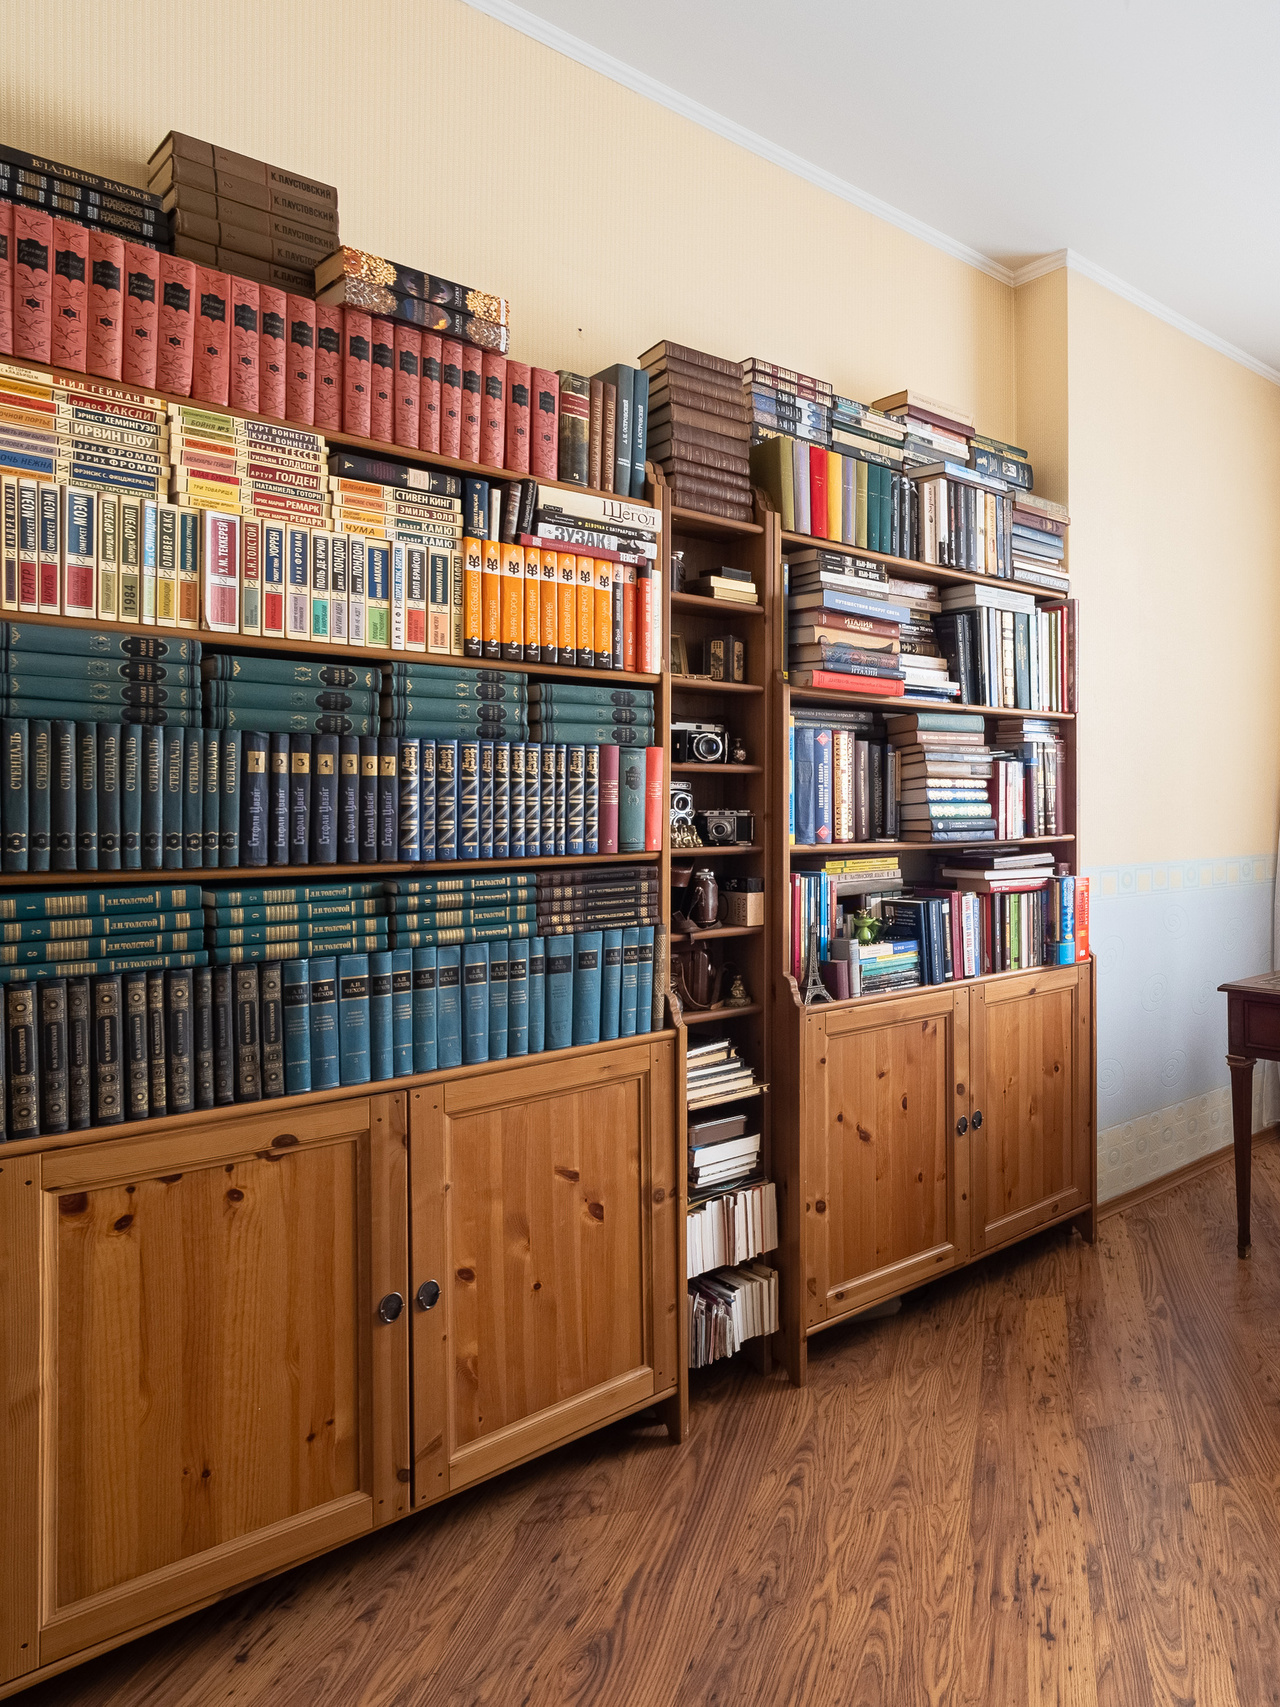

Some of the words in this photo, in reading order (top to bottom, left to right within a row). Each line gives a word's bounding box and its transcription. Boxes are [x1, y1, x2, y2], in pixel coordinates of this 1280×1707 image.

[32, 159, 99, 185] ВЛАДИМИР
[59, 379, 85, 391] НИЛ
[91, 385, 141, 403] ГЕЙМАН
[0, 411, 23, 421] ОЧНОЙ
[77, 411, 103, 423] ЭРНЕСТ
[104, 416, 157, 434] ХЕМИНГУЭЙ
[105, 404, 152, 422] ХАКСЛИ
[190, 419, 216, 430] БОЙНЯ
[248, 421, 270, 433] КУРТ
[272, 427, 315, 443] ВОННЕГУТ
[74, 424, 122, 442] ИРВИН
[123, 432, 154, 448] ШОУ
[251, 432, 272, 443] КУРТ
[275, 437, 317, 451] ВОННЕГУТ
[0, 454, 19, 463] ОЧЬ
[21, 457, 53, 470] НЕЖНА
[77, 442, 104, 454] ЭРИХ
[106, 446, 156, 463] ФРОММ
[79, 453, 106, 465] ЭРИХ
[109, 458, 158, 474] ФРОММ
[278, 457, 318, 472] ГОЛДИНГ
[72, 480, 104, 491] ГАБРИЭЛЬ
[73, 467, 102, 478] ФРЭНСИС
[108, 474, 155, 489] ФИЦДЖЕРАЛЬД
[250, 470, 273, 479] АРТУР
[275, 471, 318, 489] ГОЛДЕН
[5, 486, 15, 517] МОРУА
[255, 483, 296, 495] НАТАНИЕЛЬ
[296, 489, 322, 500] ГОТОРН
[395, 490, 429, 504] СТИВЕН
[430, 495, 452, 508] КИНГ
[21, 490, 35, 519] МОЭМ
[43, 493, 56, 520] МОЭМ
[73, 496, 88, 526] МОЭМ
[286, 500, 320, 514] РЕМАРК
[399, 506, 430, 517] ЭМИЛЬ
[432, 511, 454, 522] ЗОЛЯ
[602, 500, 656, 526] Щегол
[104, 503, 115, 534] ОРУЭЛЛ
[124, 508, 136, 540] ОРУЭЛЛ
[163, 512, 173, 533] САКС
[290, 515, 323, 527] РЕМАРК
[421, 521, 454, 535] КАМЮ
[6, 518, 16, 546] АНДРЕ
[27, 518, 35, 550] СОМЕРСЕТ
[47, 521, 56, 551] СОМЕРСЕТ
[217, 521, 229, 557] ТЕККЕРЕЙ
[345, 524, 376, 536] ЧУМА
[554, 526, 606, 549] ЗУЗАК
[162, 535, 173, 567] ОЛИВЕР
[269, 531, 280, 557] УОРРЕН
[294, 534, 303, 565] ФРОММ
[316, 539, 326, 560] КРЮИ
[422, 536, 454, 549] КАМЮ
[316, 559, 327, 570] ДЕ
[334, 540, 346, 575] ЛОНДОН
[353, 544, 364, 578] ЛОНДОН
[374, 550, 382, 583] МАККАЛОУ
[412, 551, 421, 579] БРАЙСОН
[22, 568, 35, 602] ТЕАТР
[316, 569, 326, 589] ПОЛЬ
[412, 580, 421, 598] БИЛЛ
[124, 584, 136, 611] 1984
[835, 598, 868, 611] ПУТЕШЕСТВИЯ
[885, 609, 900, 617] СВЕТА
[844, 617, 874, 629] ИТАЛИЯ
[10, 732, 23, 790] СТЕНДАЛЬ
[36, 732, 49, 790] СТЕНДАЛЬ
[60, 733, 72, 790] СТЕНДАЛЬ
[253, 757, 260, 767] 1
[297, 758, 305, 767] 3
[321, 759, 331, 768] 4
[346, 758, 353, 768] 5
[365, 761, 374, 770] 6
[384, 761, 391, 771] 7
[1076, 891, 1085, 927] English
